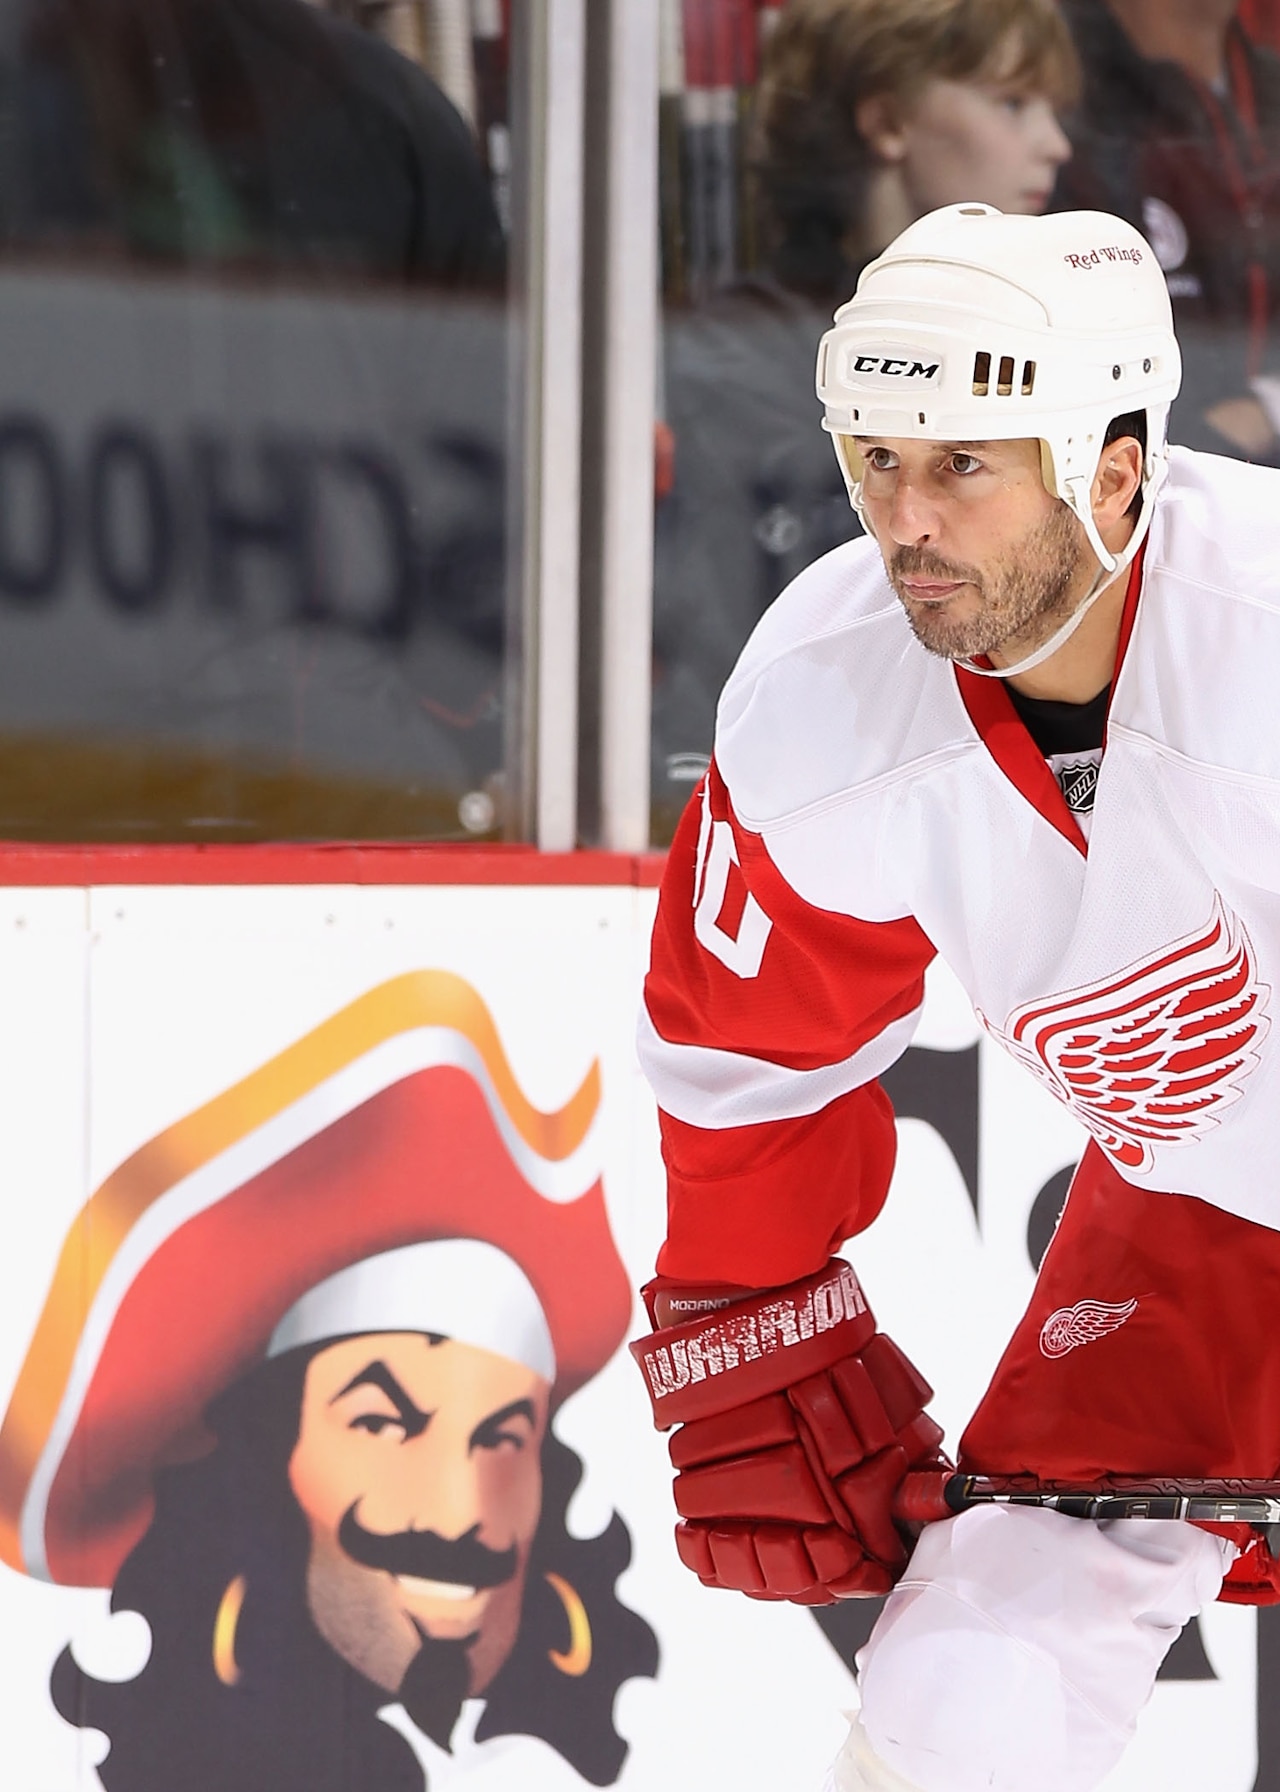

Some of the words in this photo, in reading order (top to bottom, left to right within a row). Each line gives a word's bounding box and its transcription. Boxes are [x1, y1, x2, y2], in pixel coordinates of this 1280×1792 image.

[1064, 250, 1101, 270] Red
[1099, 246, 1143, 266] Wings
[854, 356, 940, 379] CCM
[1069, 773, 1096, 805] NHL
[692, 772, 774, 979] 0
[669, 1298, 730, 1311] MODANO
